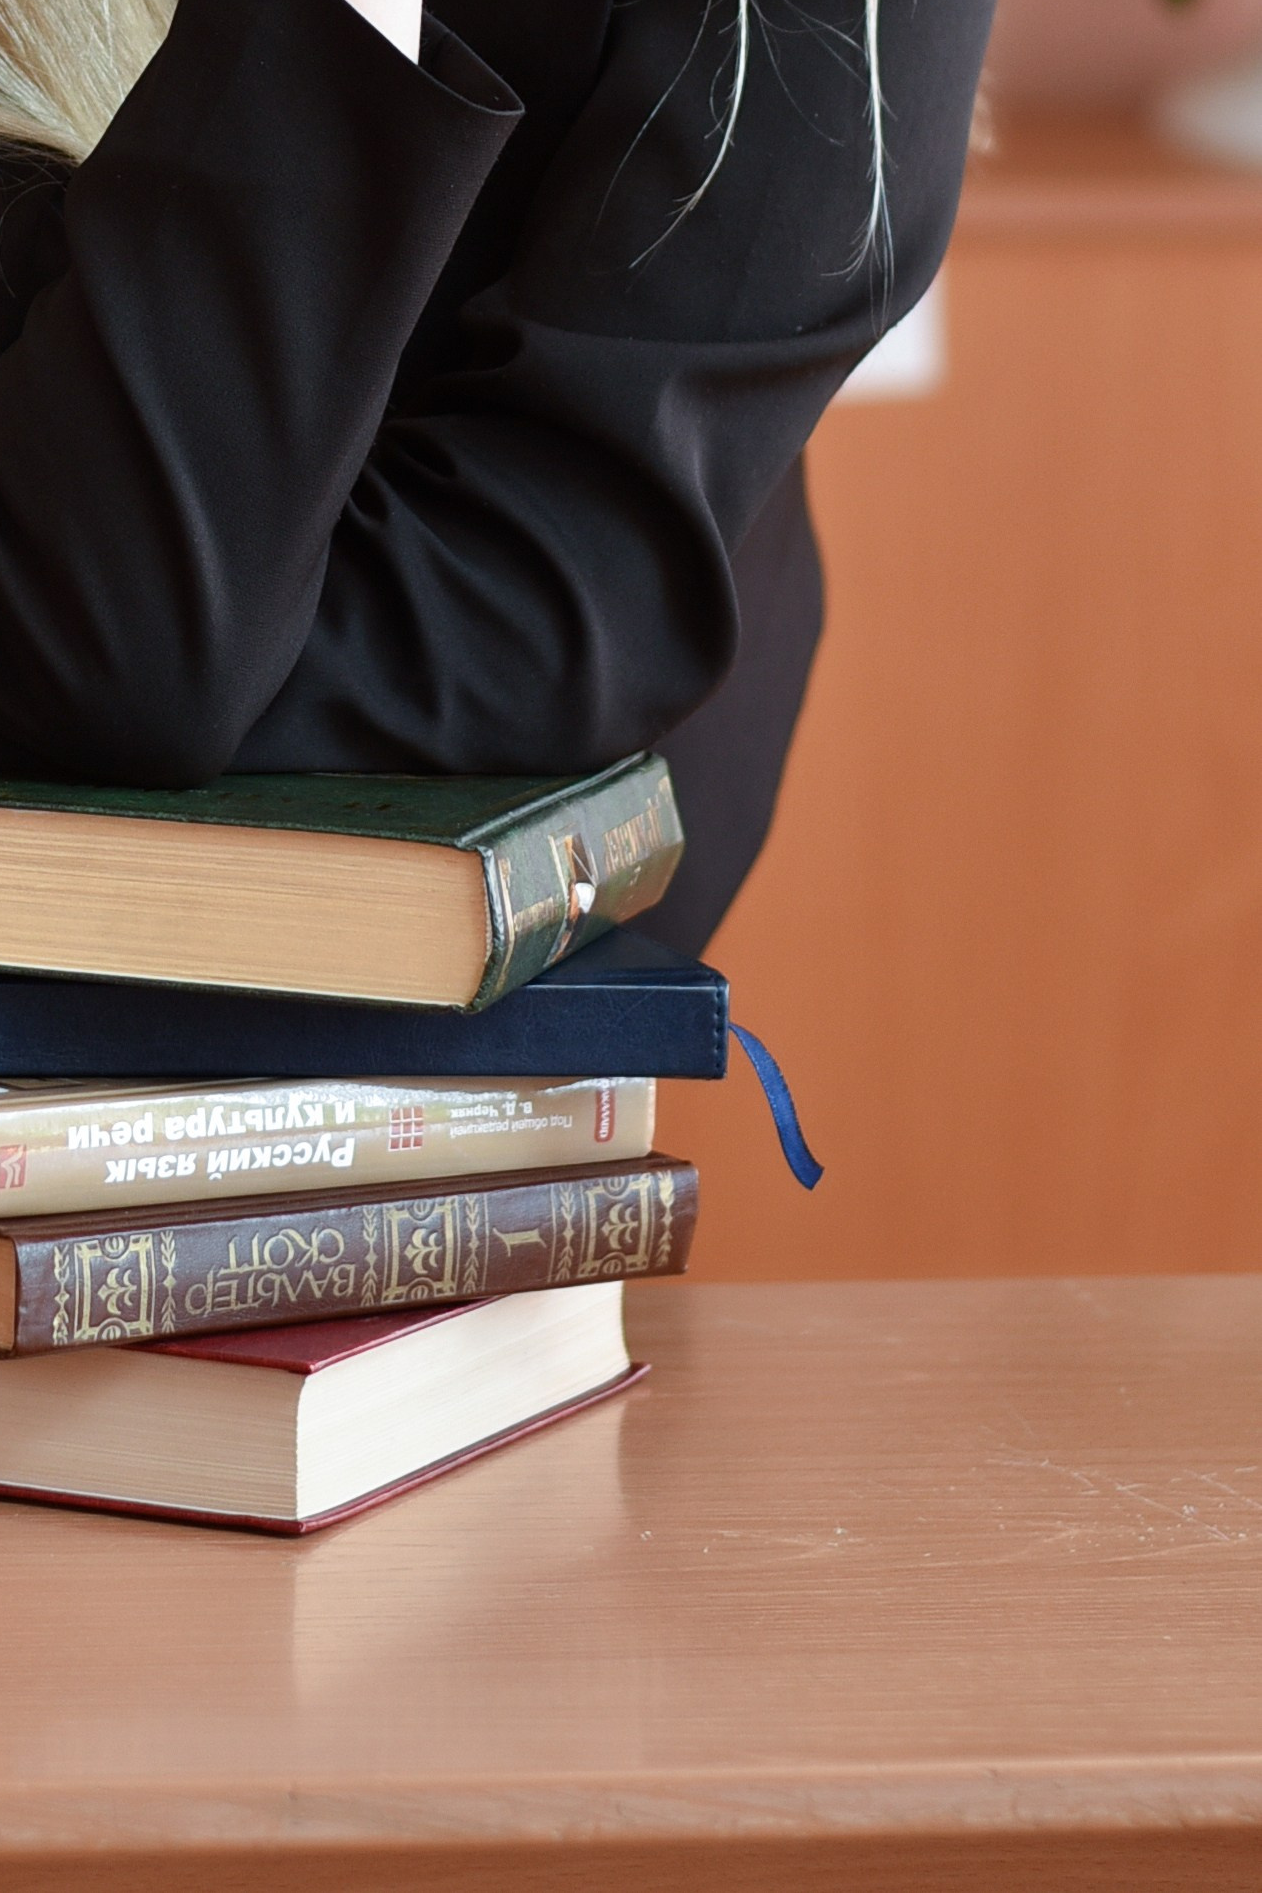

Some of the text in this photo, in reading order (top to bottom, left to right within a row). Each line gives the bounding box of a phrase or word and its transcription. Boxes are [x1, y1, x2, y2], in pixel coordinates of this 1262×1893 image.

[68, 1095, 355, 1150] и культура речи
[450, 1100, 533, 1119] В. Д. Черняк
[450, 1115, 573, 1138] Под общей редакцией
[104, 1133, 355, 1183] Русский язык
[217, 1227, 345, 1277] СКОТТ
[185, 1264, 356, 1317] ВАЛЬТЕР
